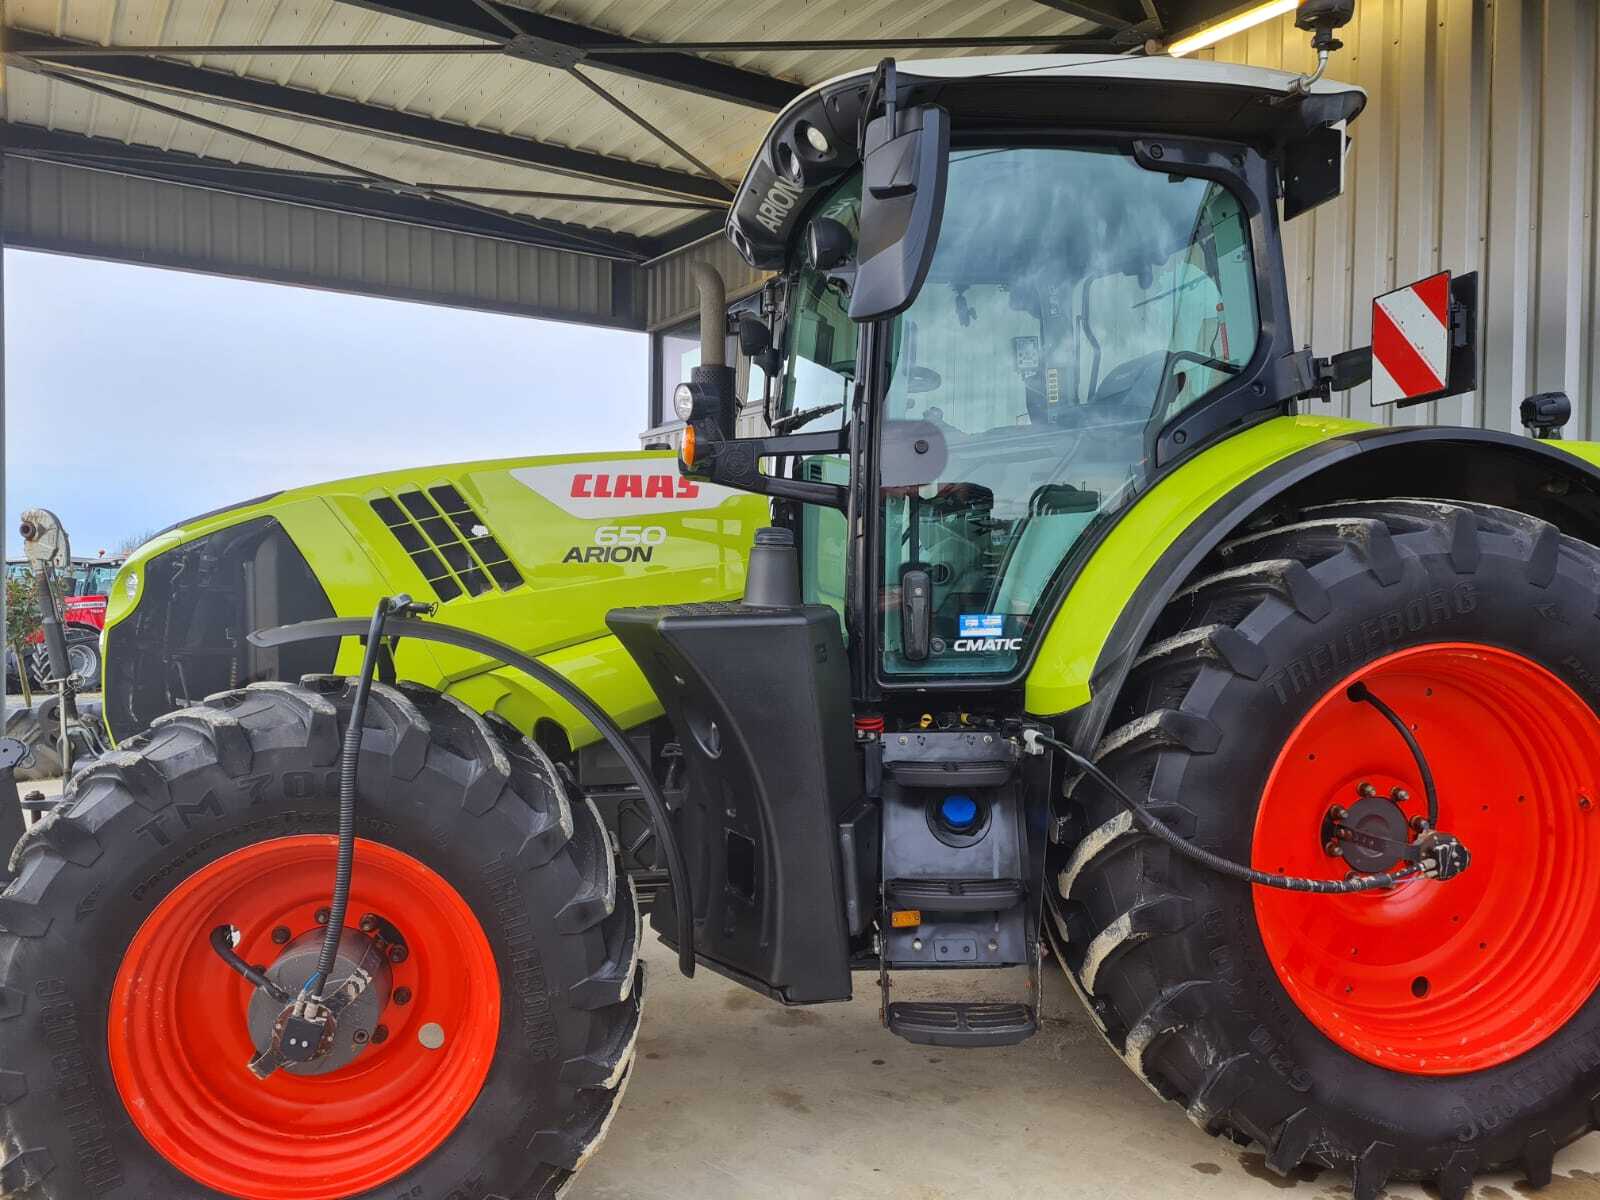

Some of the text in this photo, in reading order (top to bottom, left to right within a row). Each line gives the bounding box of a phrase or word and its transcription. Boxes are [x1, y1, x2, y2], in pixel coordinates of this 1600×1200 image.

[755, 175, 804, 234] ARION
[571, 474, 700, 499] CLAAS
[593, 525, 667, 546] 650
[562, 546, 654, 564] ARION
[953, 638, 1023, 652] CMATIC
[1263, 580, 1479, 705] TRELLEBORG
[130, 788, 226, 848] TM
